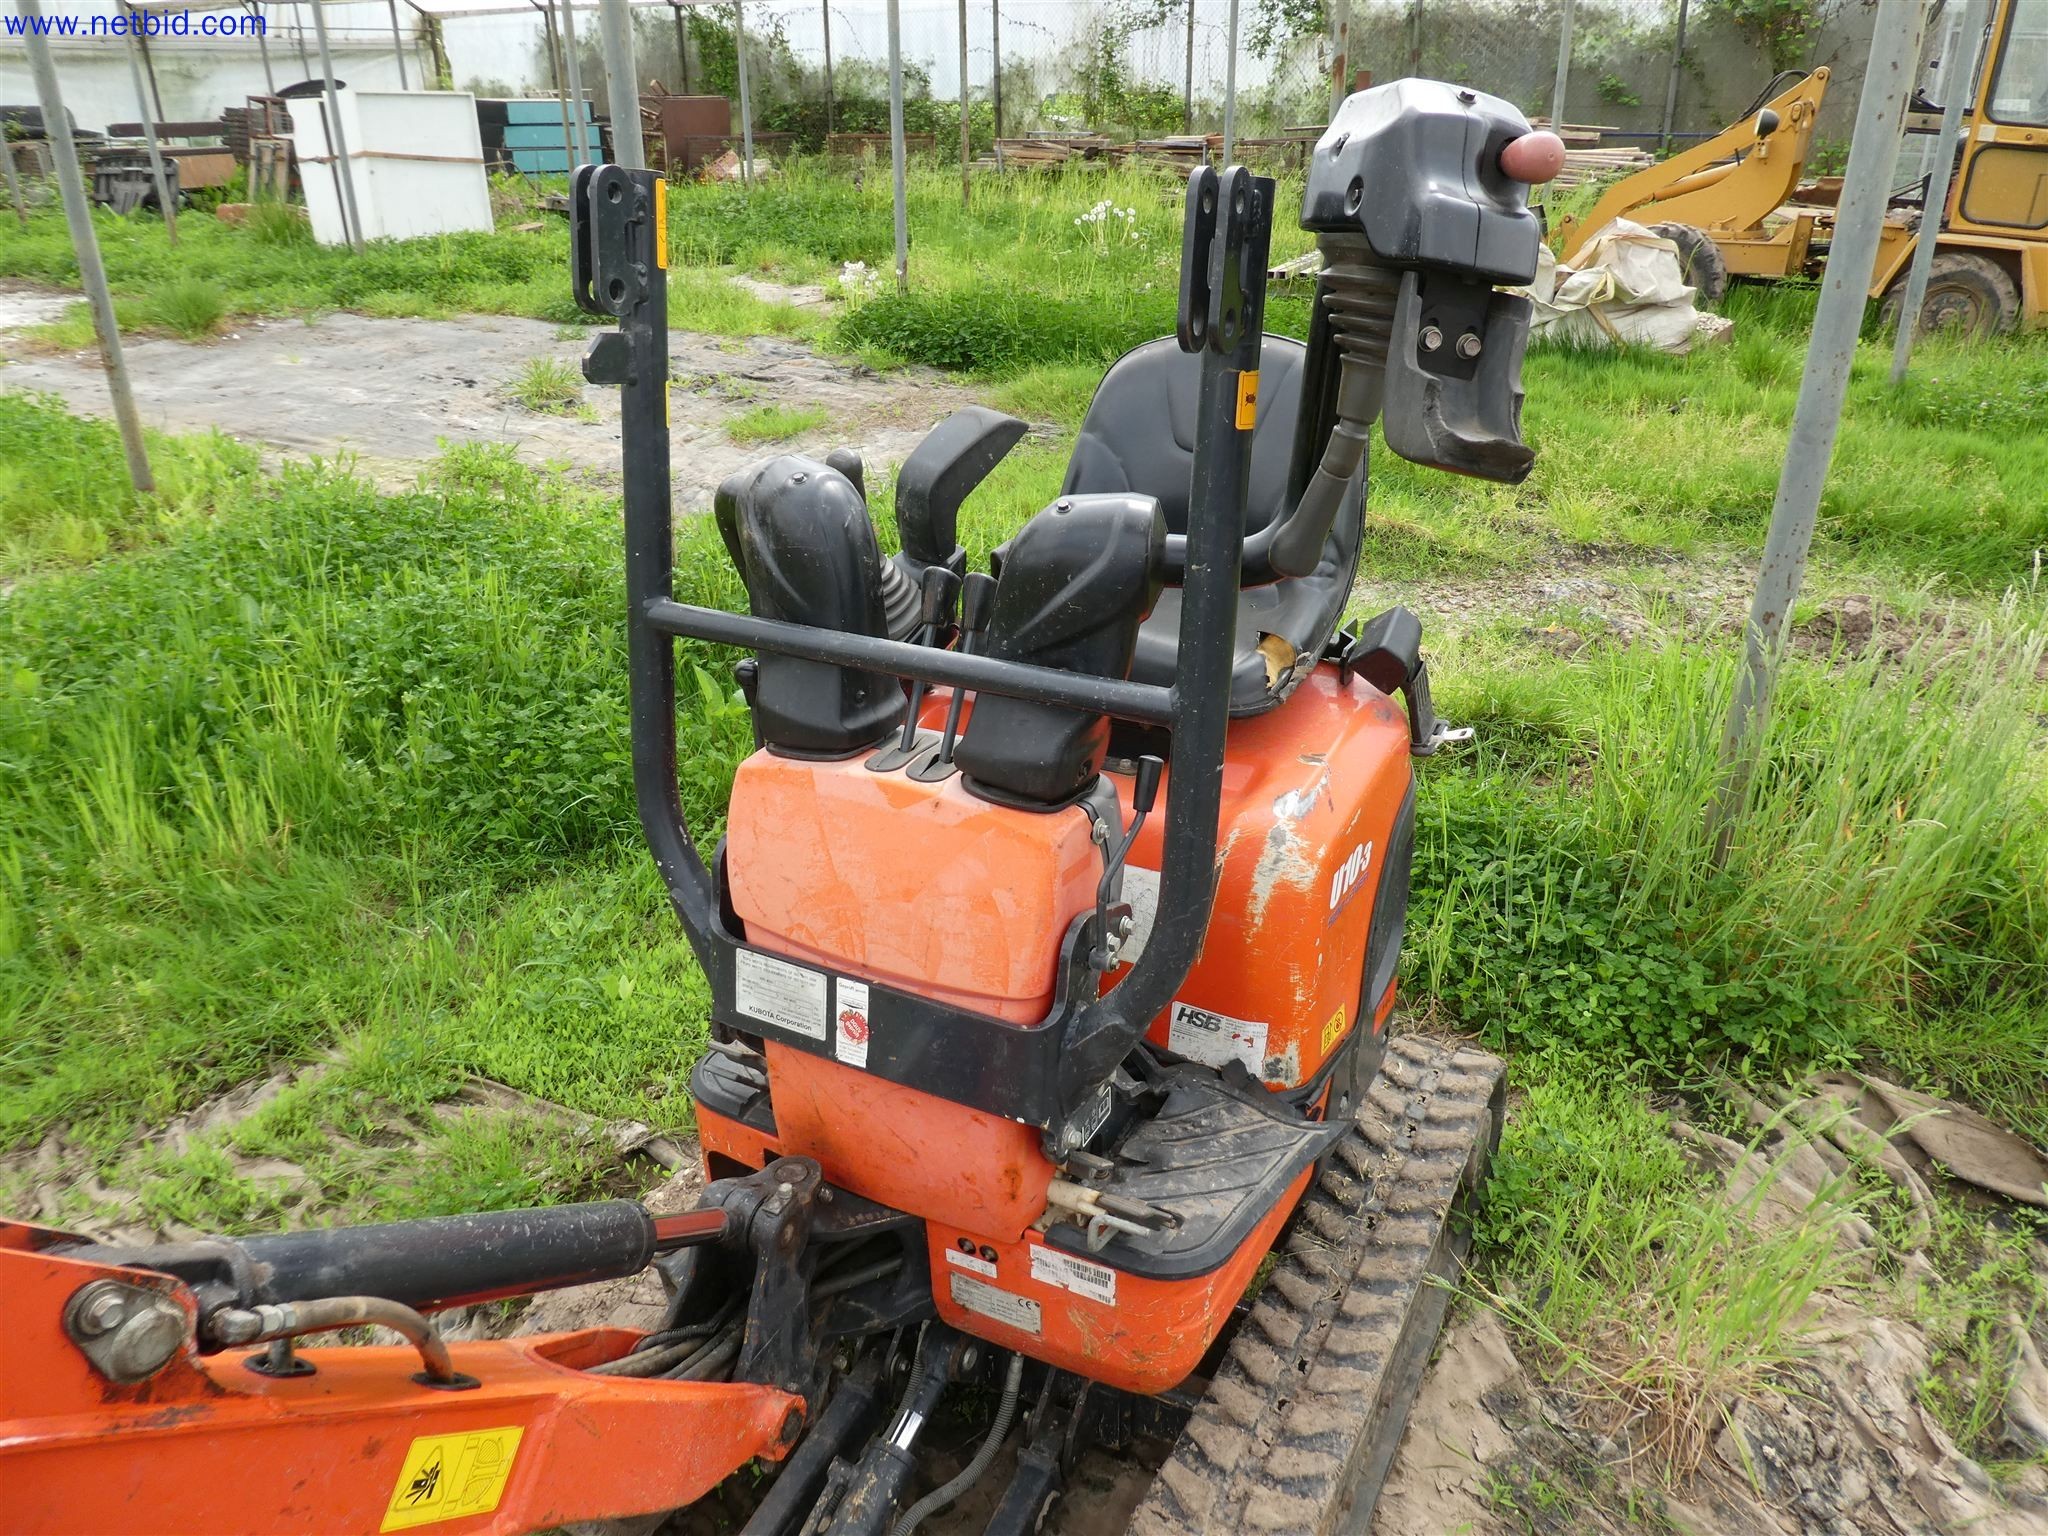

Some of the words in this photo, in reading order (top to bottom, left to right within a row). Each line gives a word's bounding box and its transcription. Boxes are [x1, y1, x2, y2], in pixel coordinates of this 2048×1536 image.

[1329, 840, 1373, 910] U10-3
[748, 1005, 774, 1019] KUBOTA
[776, 1014, 812, 1031] Corporation
[1176, 1006, 1221, 1032] HSB
